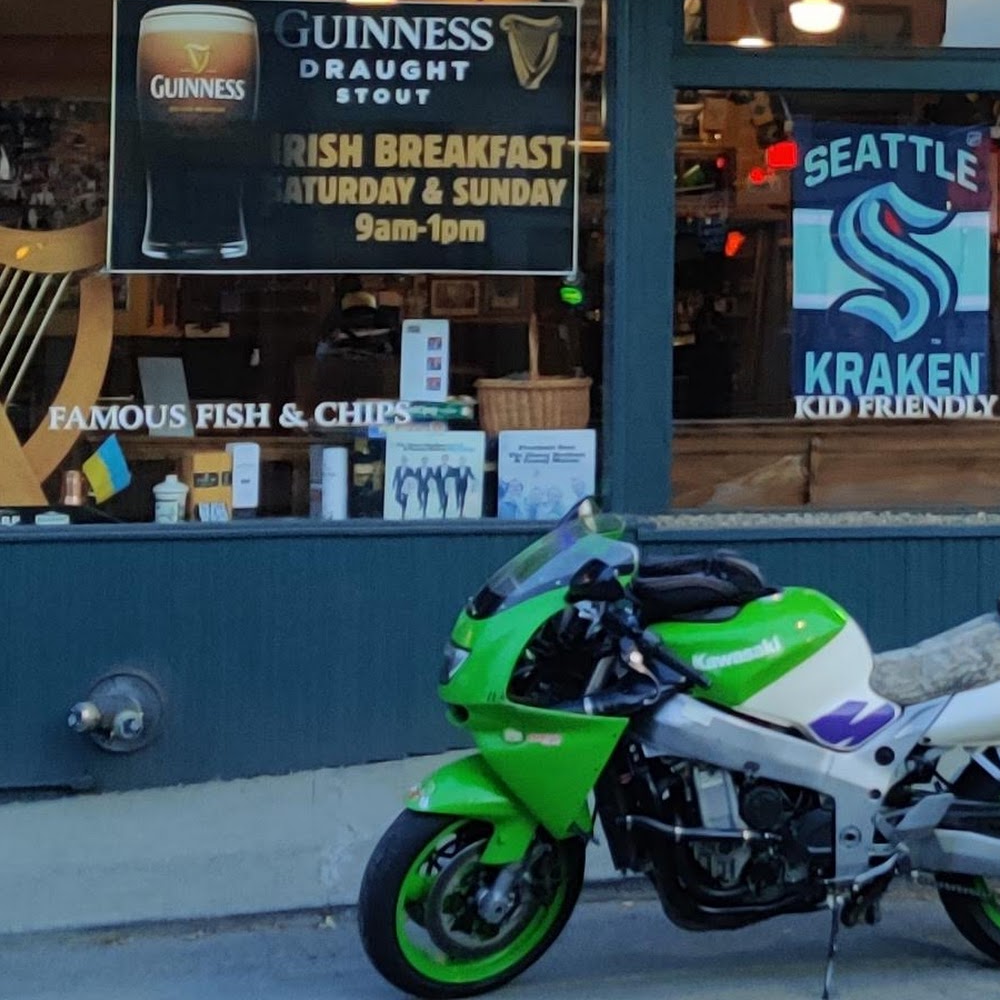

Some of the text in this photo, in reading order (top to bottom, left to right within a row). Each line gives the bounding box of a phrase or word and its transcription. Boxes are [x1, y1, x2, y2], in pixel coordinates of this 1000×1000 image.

[275, 9, 494, 50] GUINNESS
[300, 58, 470, 82] DRAUGHT
[150, 74, 246, 101] GUINNESS
[336, 87, 431, 105] STOUT
[374, 133, 567, 169] BREAKFAST
[804, 133, 979, 193] SEATTLE
[272, 176, 568, 207] ATURDAY & SUNDAY
[355, 212, 486, 246] 9am-1pm
[804, 351, 981, 395] KRAKEN
[48, 399, 413, 430] FAMOUS FISH & CHIPS
[794, 395, 999, 419] KID FRIENDLY
